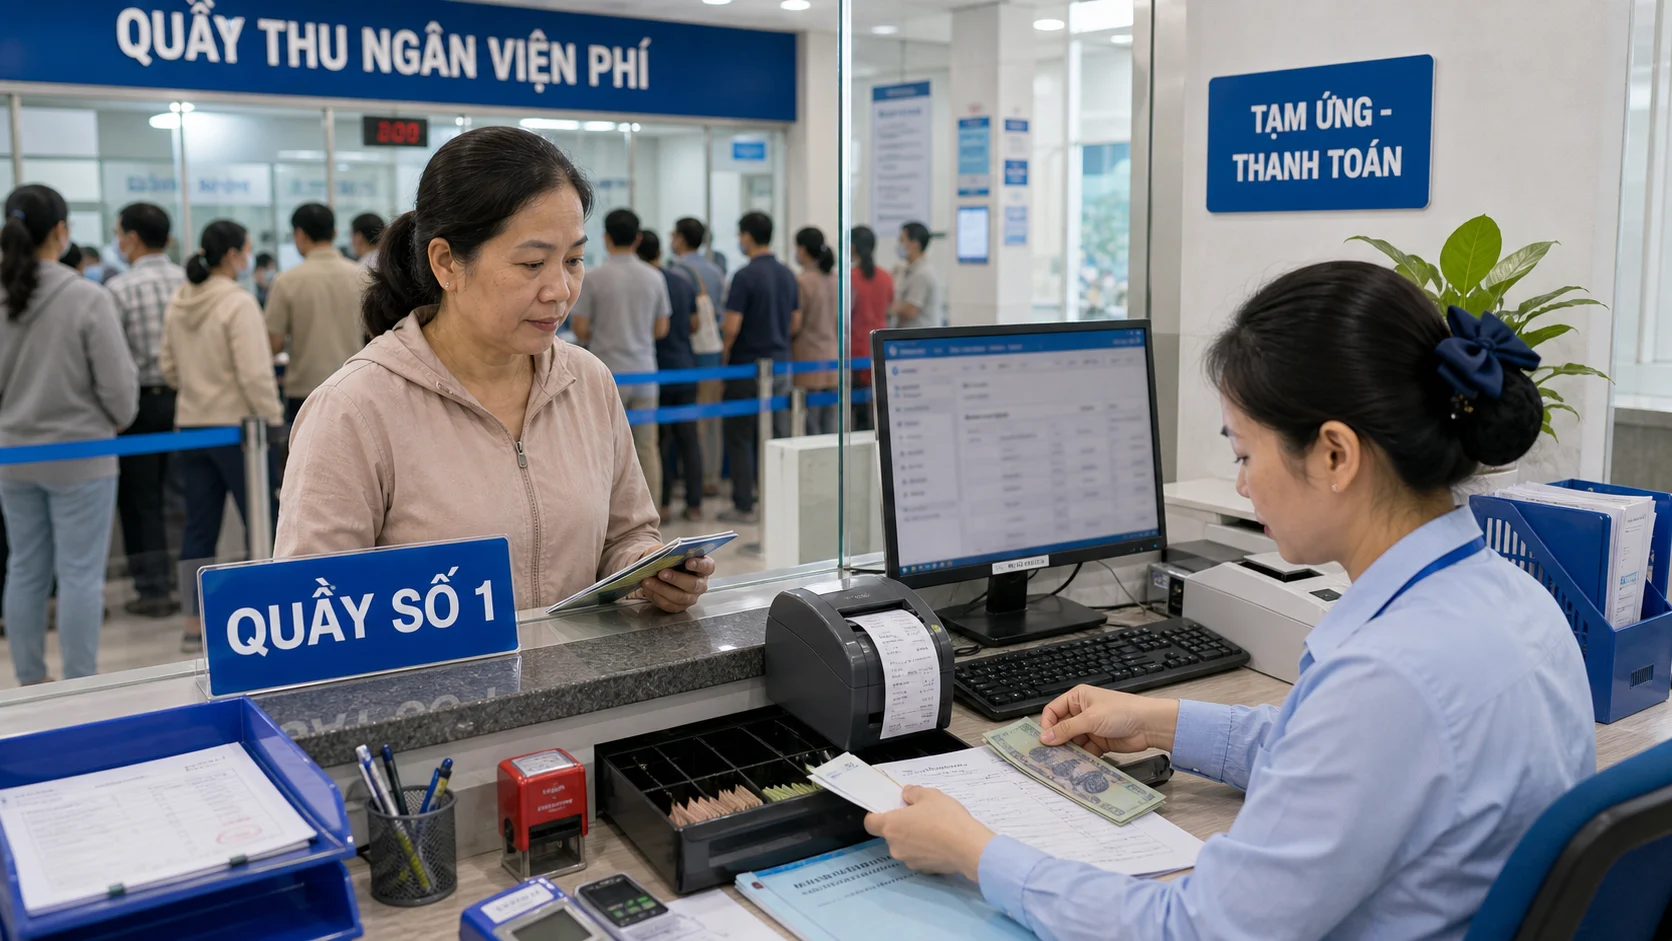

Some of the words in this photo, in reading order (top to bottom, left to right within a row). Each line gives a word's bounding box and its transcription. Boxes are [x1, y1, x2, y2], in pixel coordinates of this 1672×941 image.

[257, 18, 349, 72] THU
[361, 21, 478, 80] NGÂN
[487, 28, 577, 94] VIỆN
[587, 37, 652, 91] PHÍ
[1250, 101, 1307, 140] TẠM
[1316, 91, 1373, 130] ỨNG
[1232, 150, 1320, 183] THANH
[1327, 138, 1403, 179] TOÁN
[227, 577, 374, 657] QUẦY
[392, 566, 460, 634] SỐ
[474, 579, 495, 622] 1
